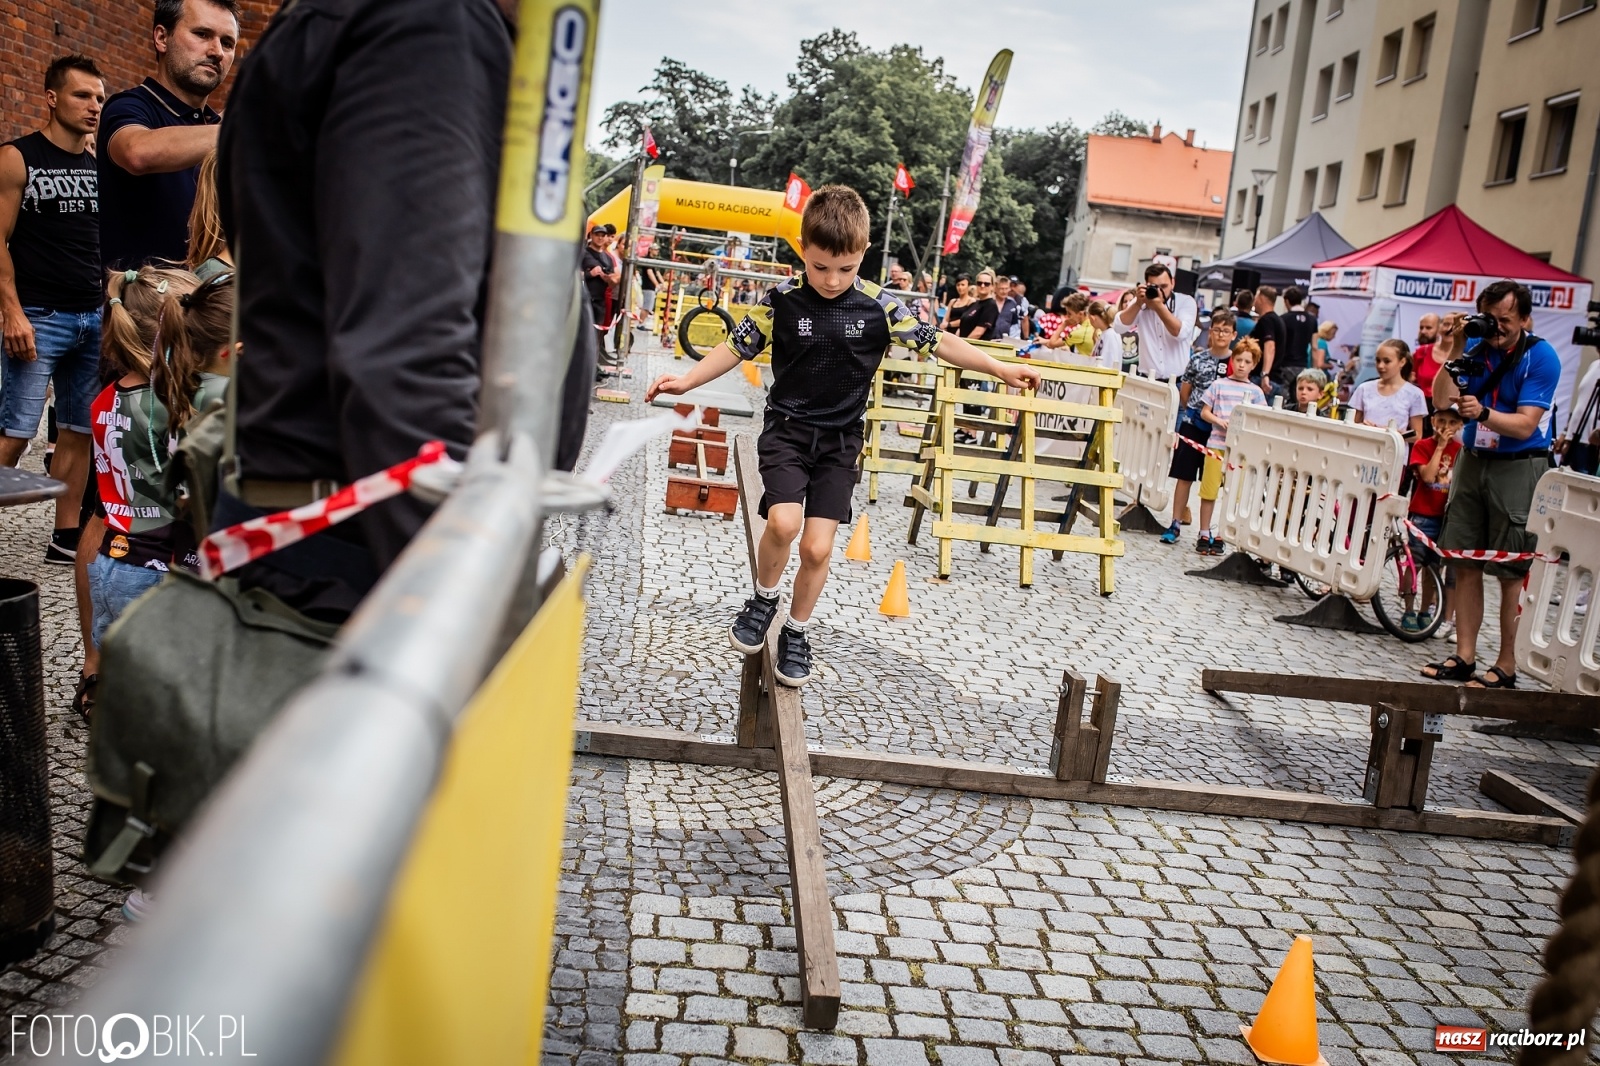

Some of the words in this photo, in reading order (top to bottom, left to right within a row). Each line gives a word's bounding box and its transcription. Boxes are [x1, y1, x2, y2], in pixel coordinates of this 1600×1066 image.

[59, 199, 85, 213] DES
[676, 198, 716, 210] MIASTO
[717, 202, 772, 217] RACIBÓRZ
[1395, 277, 1472, 301] nowiny.pl
[135, 507, 161, 518] TEAM
